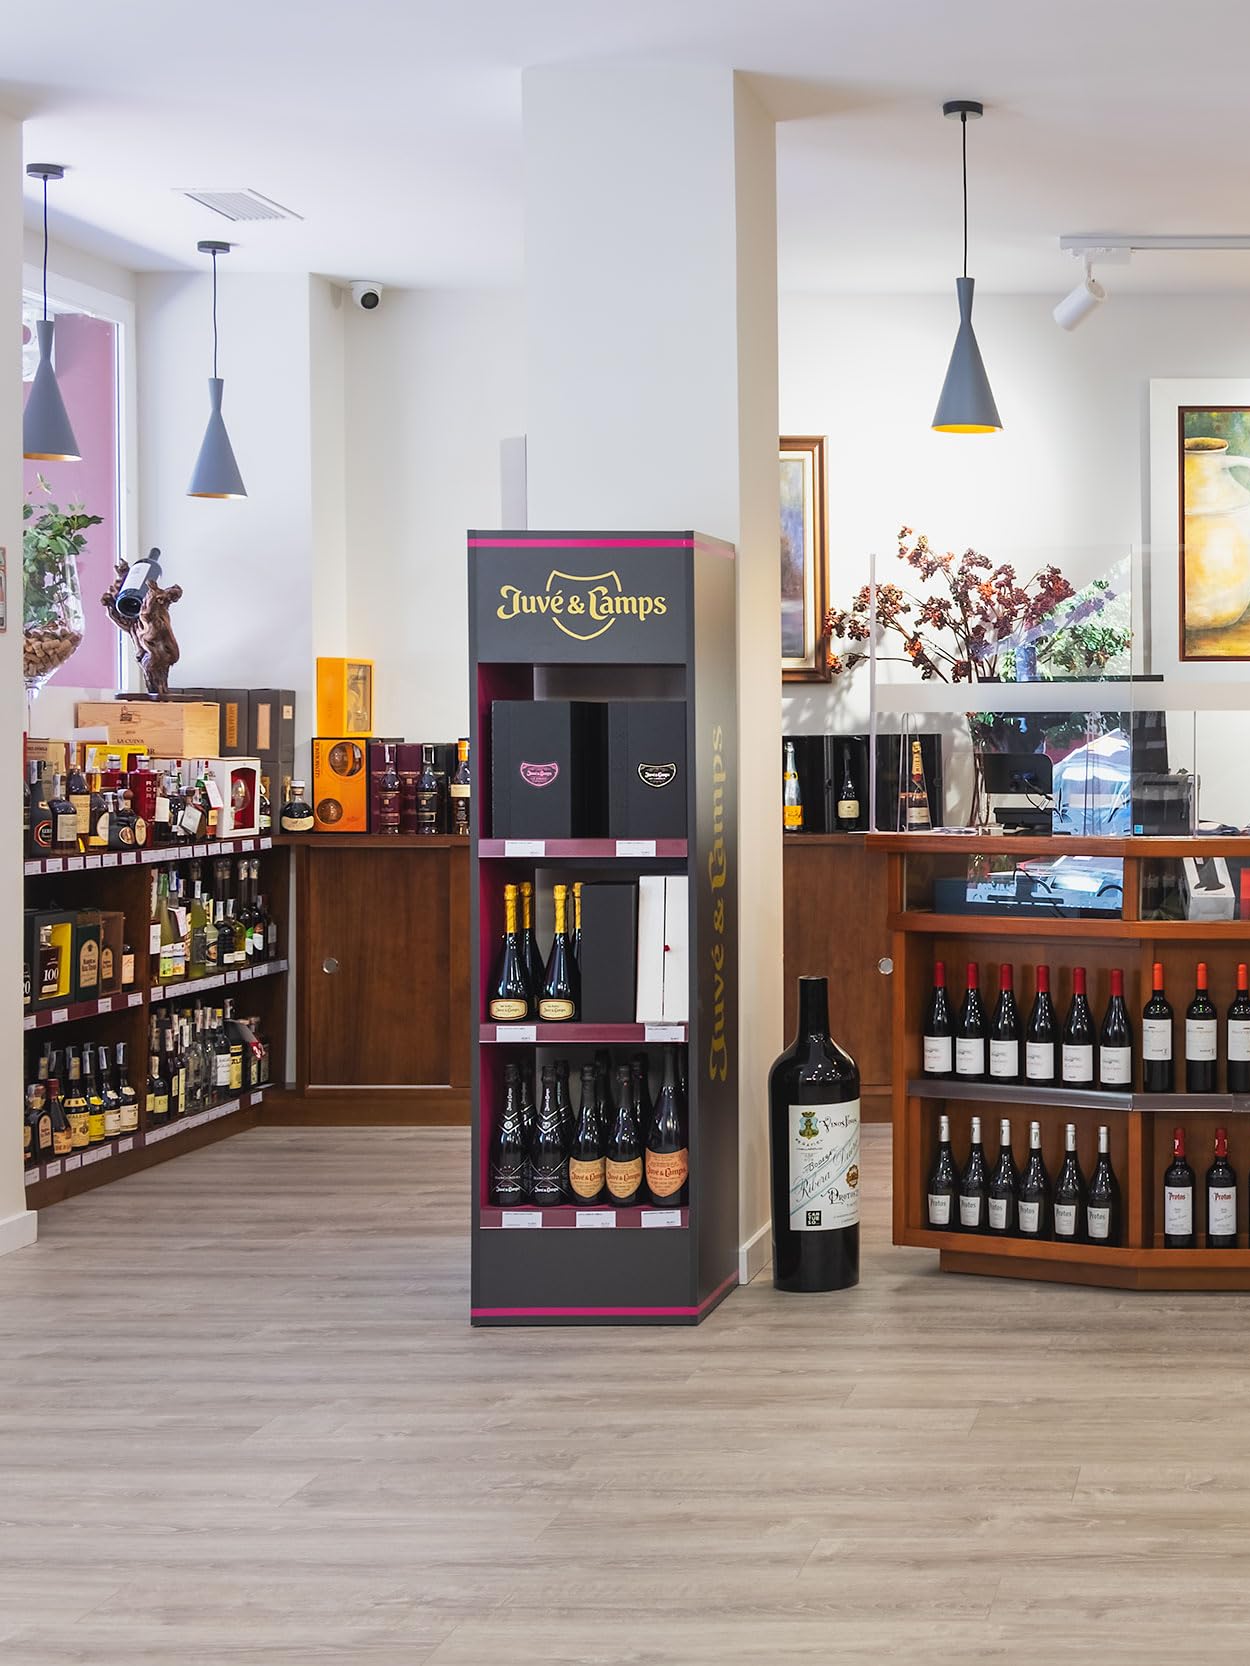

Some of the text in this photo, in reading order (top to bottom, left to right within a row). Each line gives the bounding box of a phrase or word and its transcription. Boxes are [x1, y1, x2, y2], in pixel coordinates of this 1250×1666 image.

[497, 584, 668, 621] Juvé & Camps
[708, 725, 728, 1082] Juvé & Camps
[43, 968, 60, 982] 100
[1168, 1191, 1186, 1201] Protos
[1213, 1191, 1232, 1202] Protos
